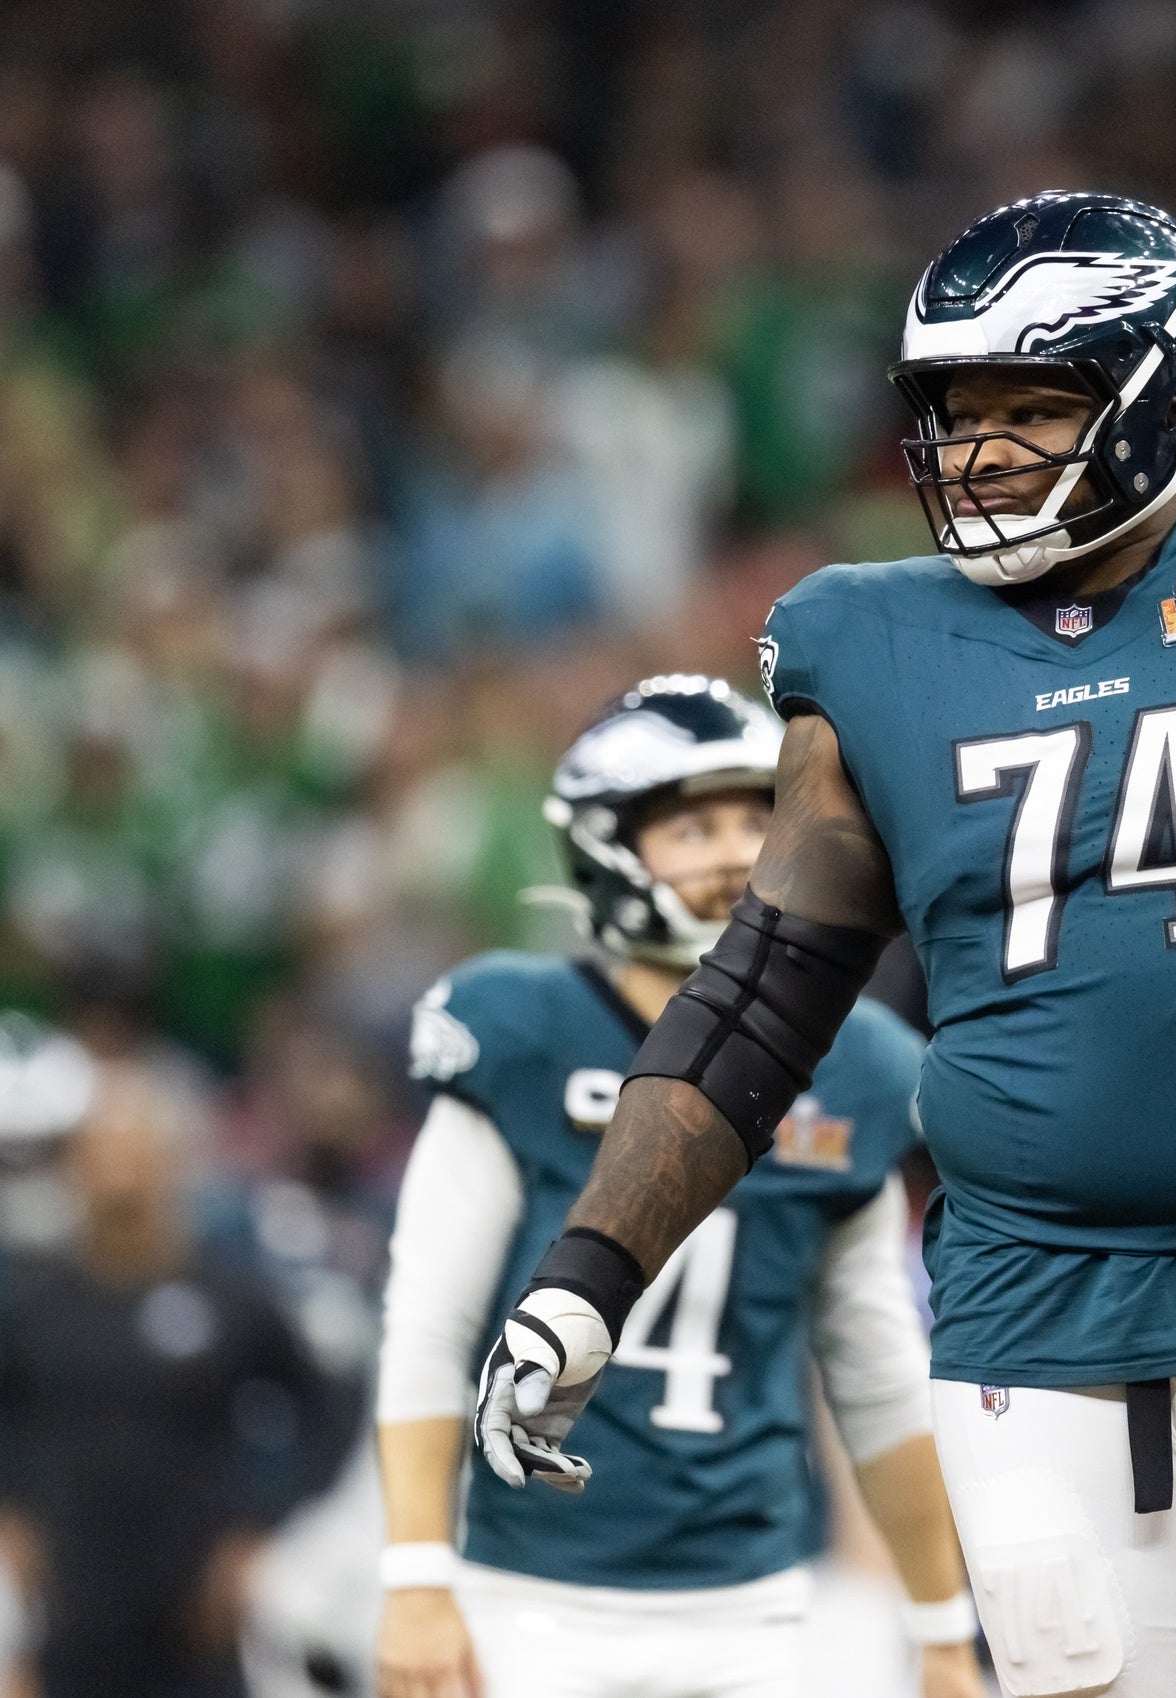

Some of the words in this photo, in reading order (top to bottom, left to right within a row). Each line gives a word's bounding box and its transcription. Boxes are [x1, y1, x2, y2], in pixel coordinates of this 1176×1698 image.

[1061, 617, 1087, 630] NFL
[1035, 677, 1130, 712] EAGLES
[611, 1206, 733, 1434] 4
[983, 1390, 1005, 1411] NFL
